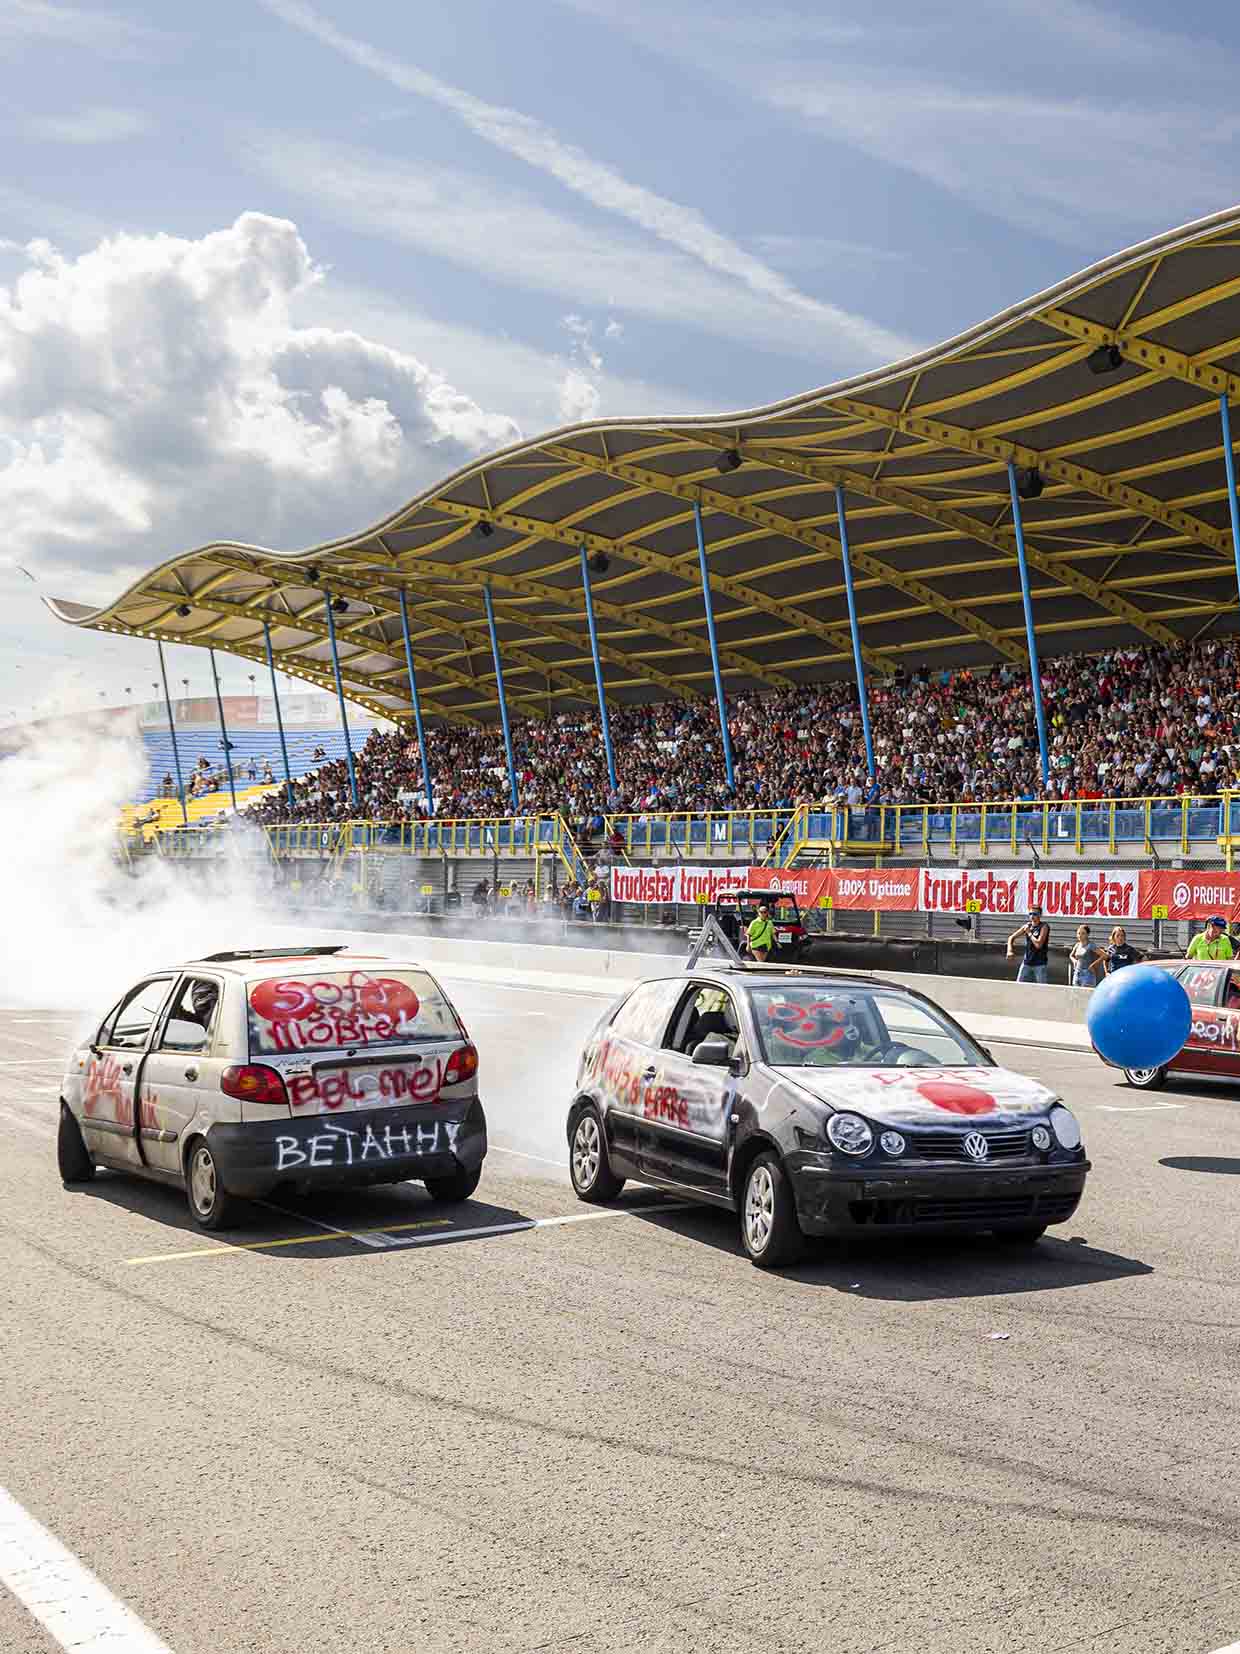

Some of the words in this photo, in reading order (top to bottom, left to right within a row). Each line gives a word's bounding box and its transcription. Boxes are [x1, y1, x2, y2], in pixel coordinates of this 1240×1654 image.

[714, 824, 726, 840] M
[1057, 816, 1068, 837] L
[614, 868, 674, 901] truckstar
[838, 880, 866, 896] 100%
[870, 880, 911, 898] Uptime
[924, 870, 1018, 912] truckstar
[1028, 871, 1134, 916] truckstar
[1194, 887, 1235, 905] PROFILE
[969, 902, 977, 912] 6
[1155, 907, 1163, 918] 5
